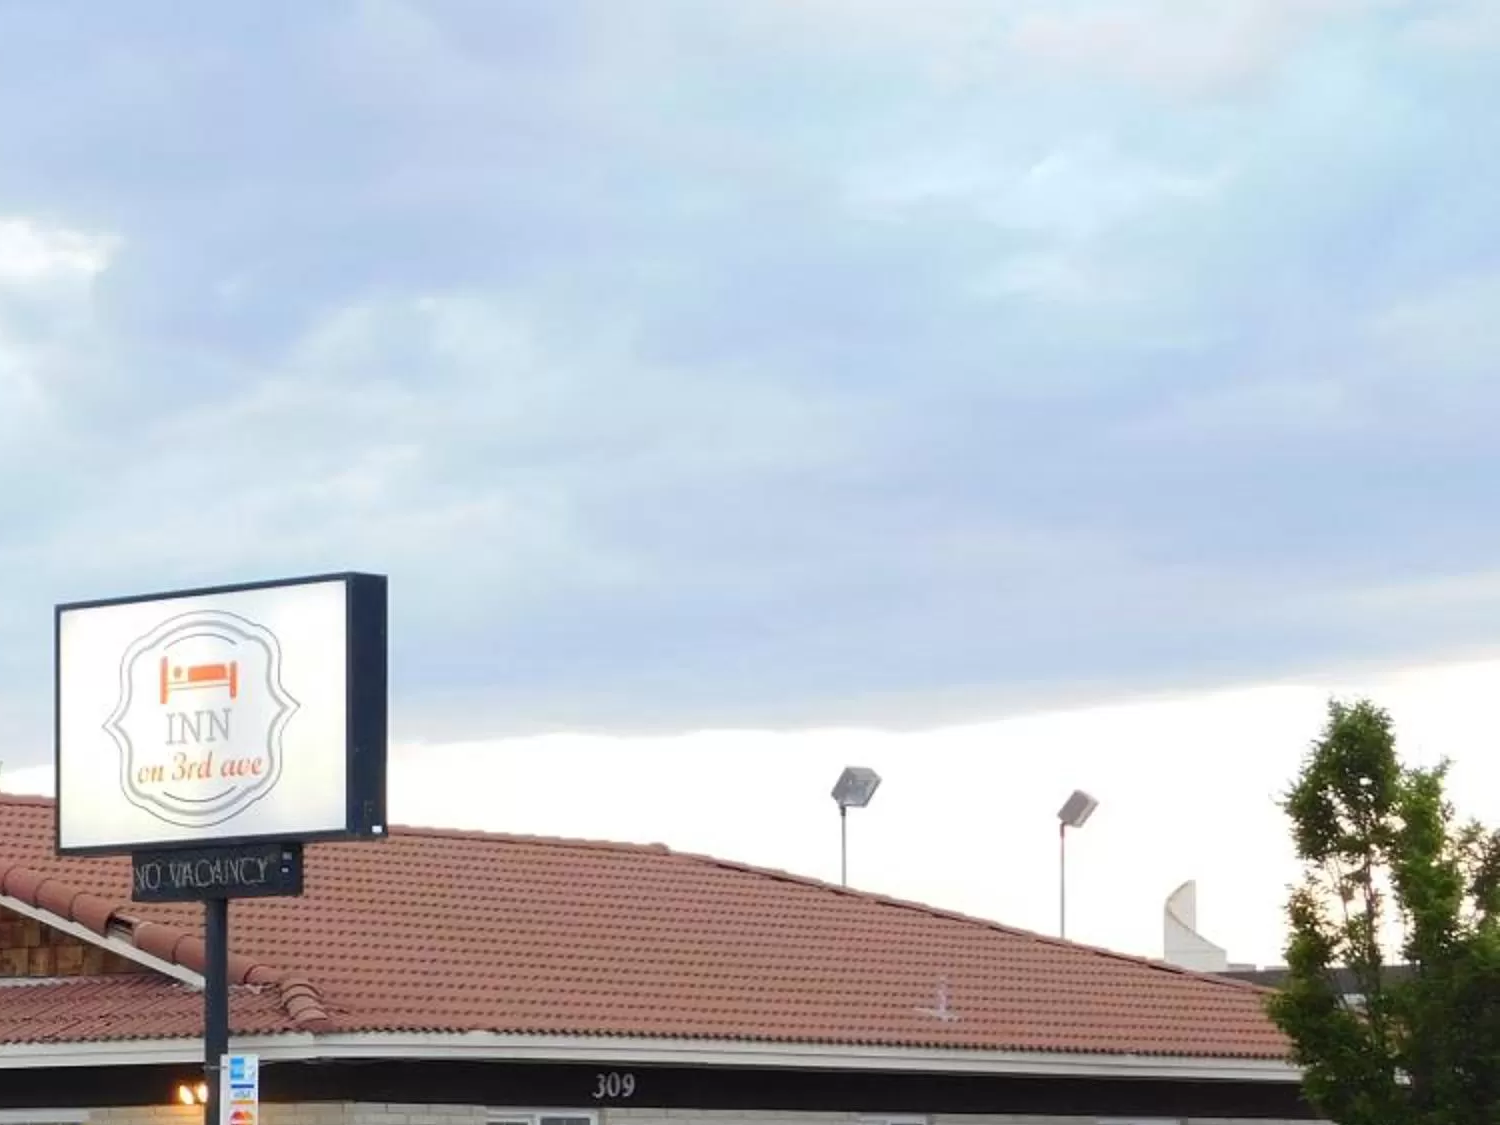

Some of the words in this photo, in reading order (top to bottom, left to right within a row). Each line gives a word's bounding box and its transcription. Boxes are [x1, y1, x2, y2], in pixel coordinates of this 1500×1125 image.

[165, 708, 232, 746] INN
[137, 765, 165, 784] on
[171, 750, 213, 781] 3rd
[221, 757, 263, 777] ave
[135, 863, 161, 891] NO
[169, 856, 269, 888] VACANCY
[592, 1072, 635, 1099] 309
